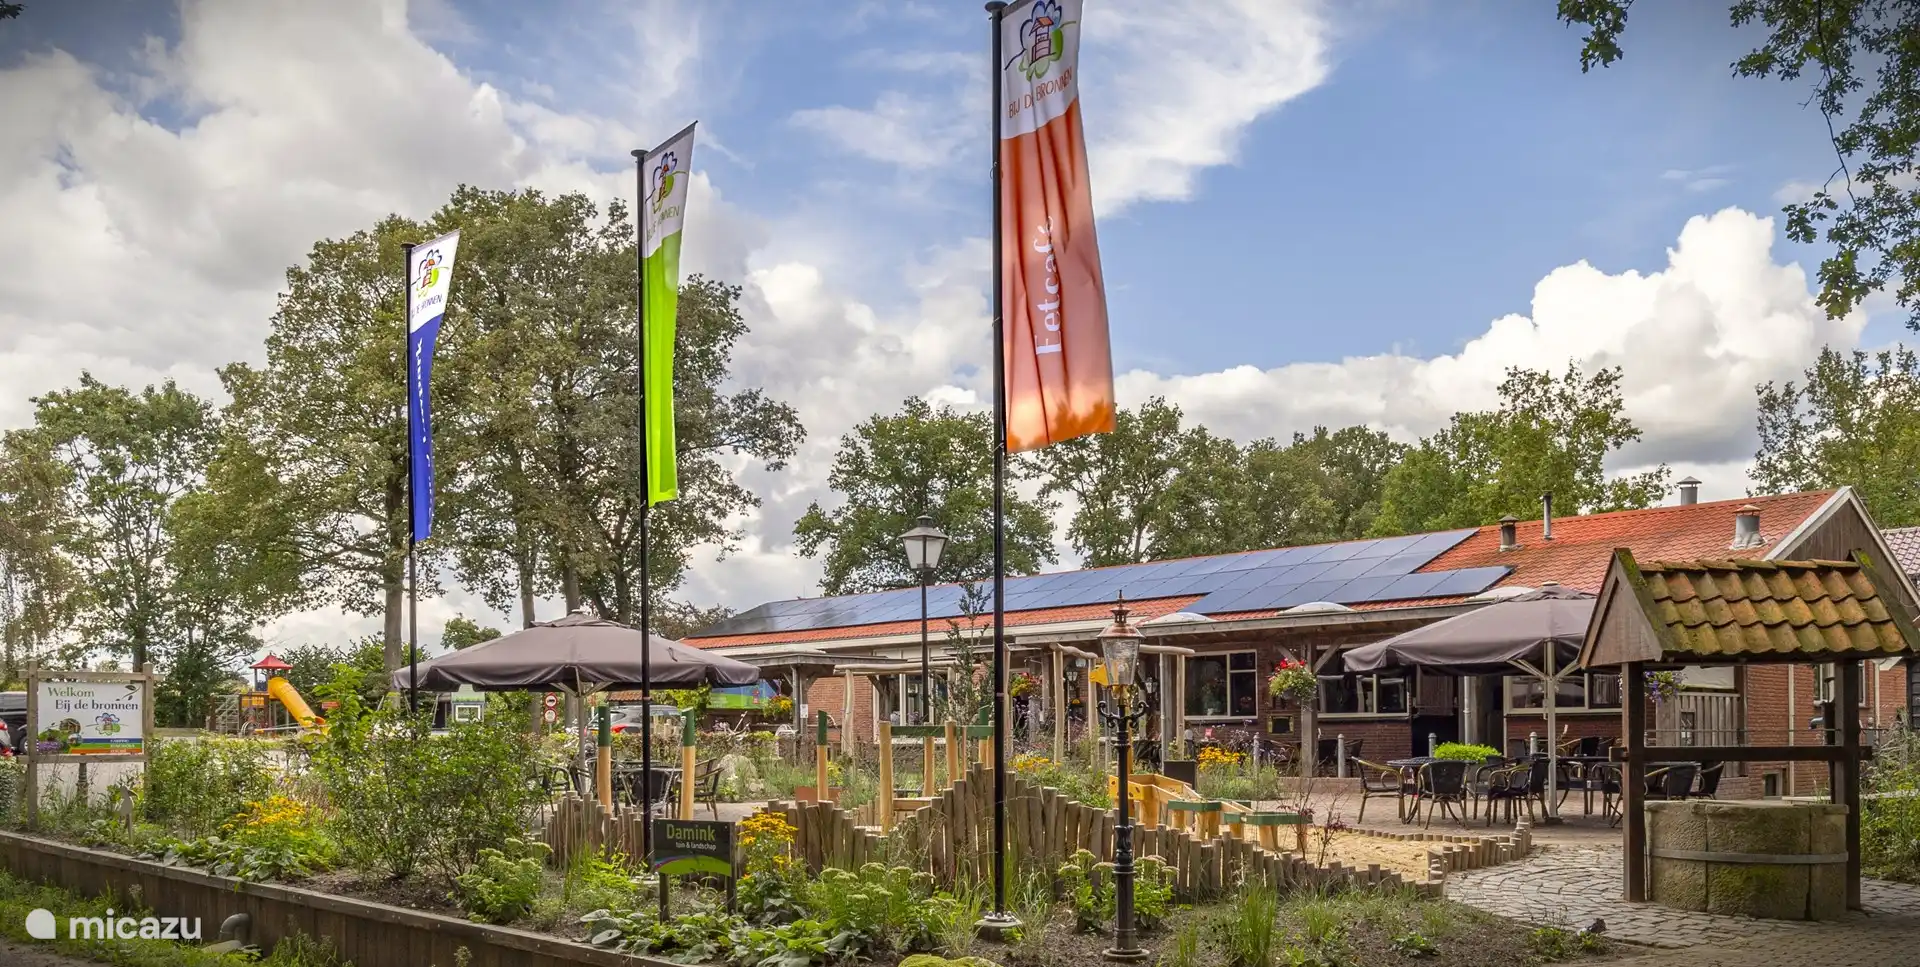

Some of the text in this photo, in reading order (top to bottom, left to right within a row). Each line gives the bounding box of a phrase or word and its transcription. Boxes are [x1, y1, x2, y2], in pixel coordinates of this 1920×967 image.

[1008, 97, 1020, 119] BIJ
[47, 686, 95, 698] Welkom
[55, 699, 138, 713] Bij de bronnen
[666, 823, 716, 841] Damink
[691, 841, 717, 851] landschap
